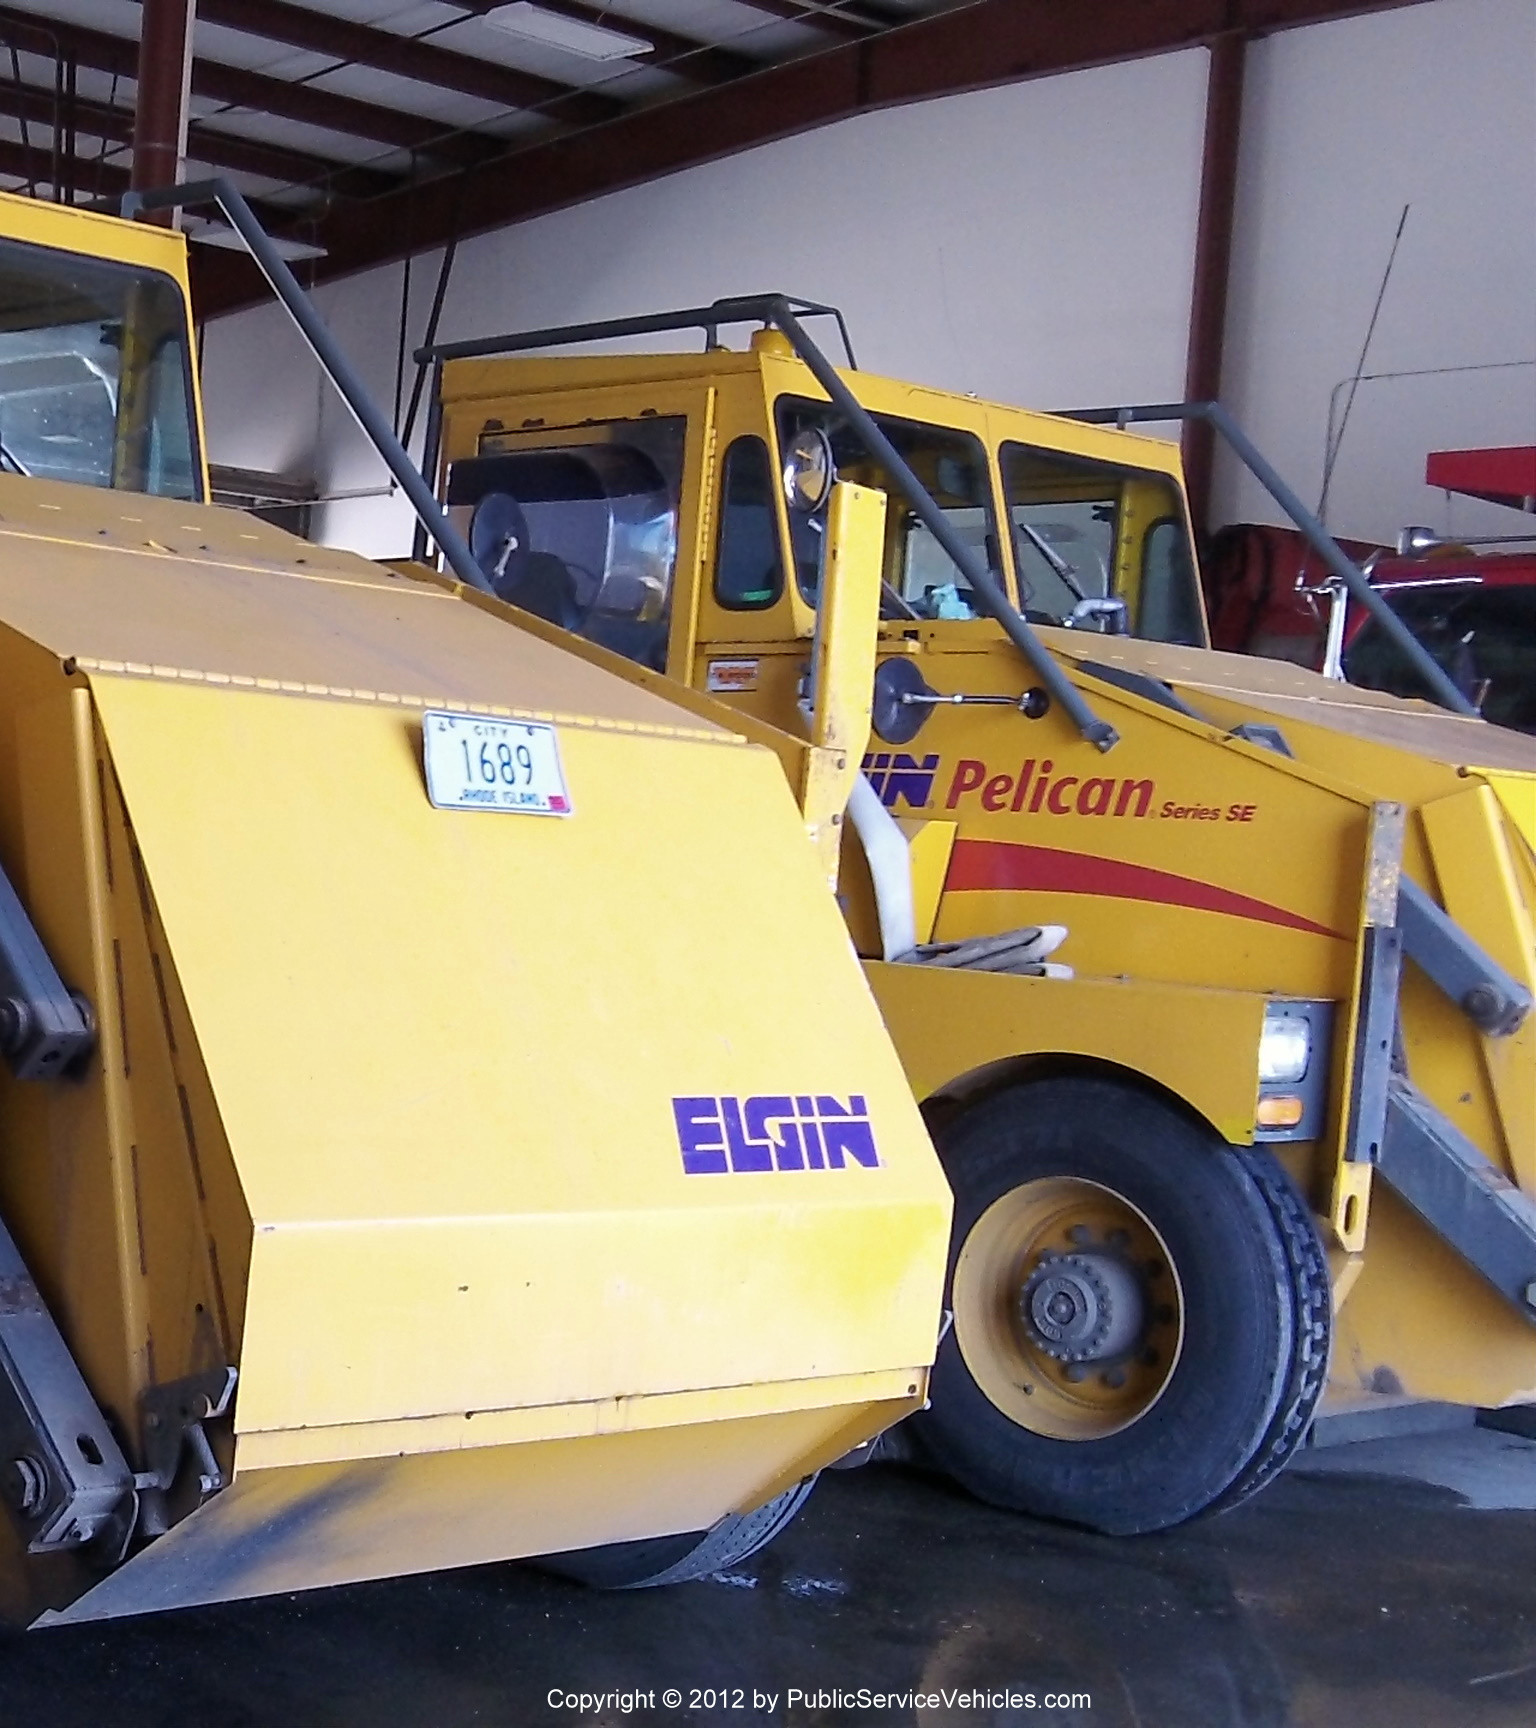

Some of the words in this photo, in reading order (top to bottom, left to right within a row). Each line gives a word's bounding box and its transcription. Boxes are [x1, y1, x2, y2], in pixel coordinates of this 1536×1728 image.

[473, 724, 508, 737] CITY
[462, 740, 533, 785] 1689
[945, 759, 1155, 818] Pelican
[1160, 801, 1221, 821] Series
[1225, 803, 1258, 822] SE
[671, 1095, 880, 1174] ELGIN
